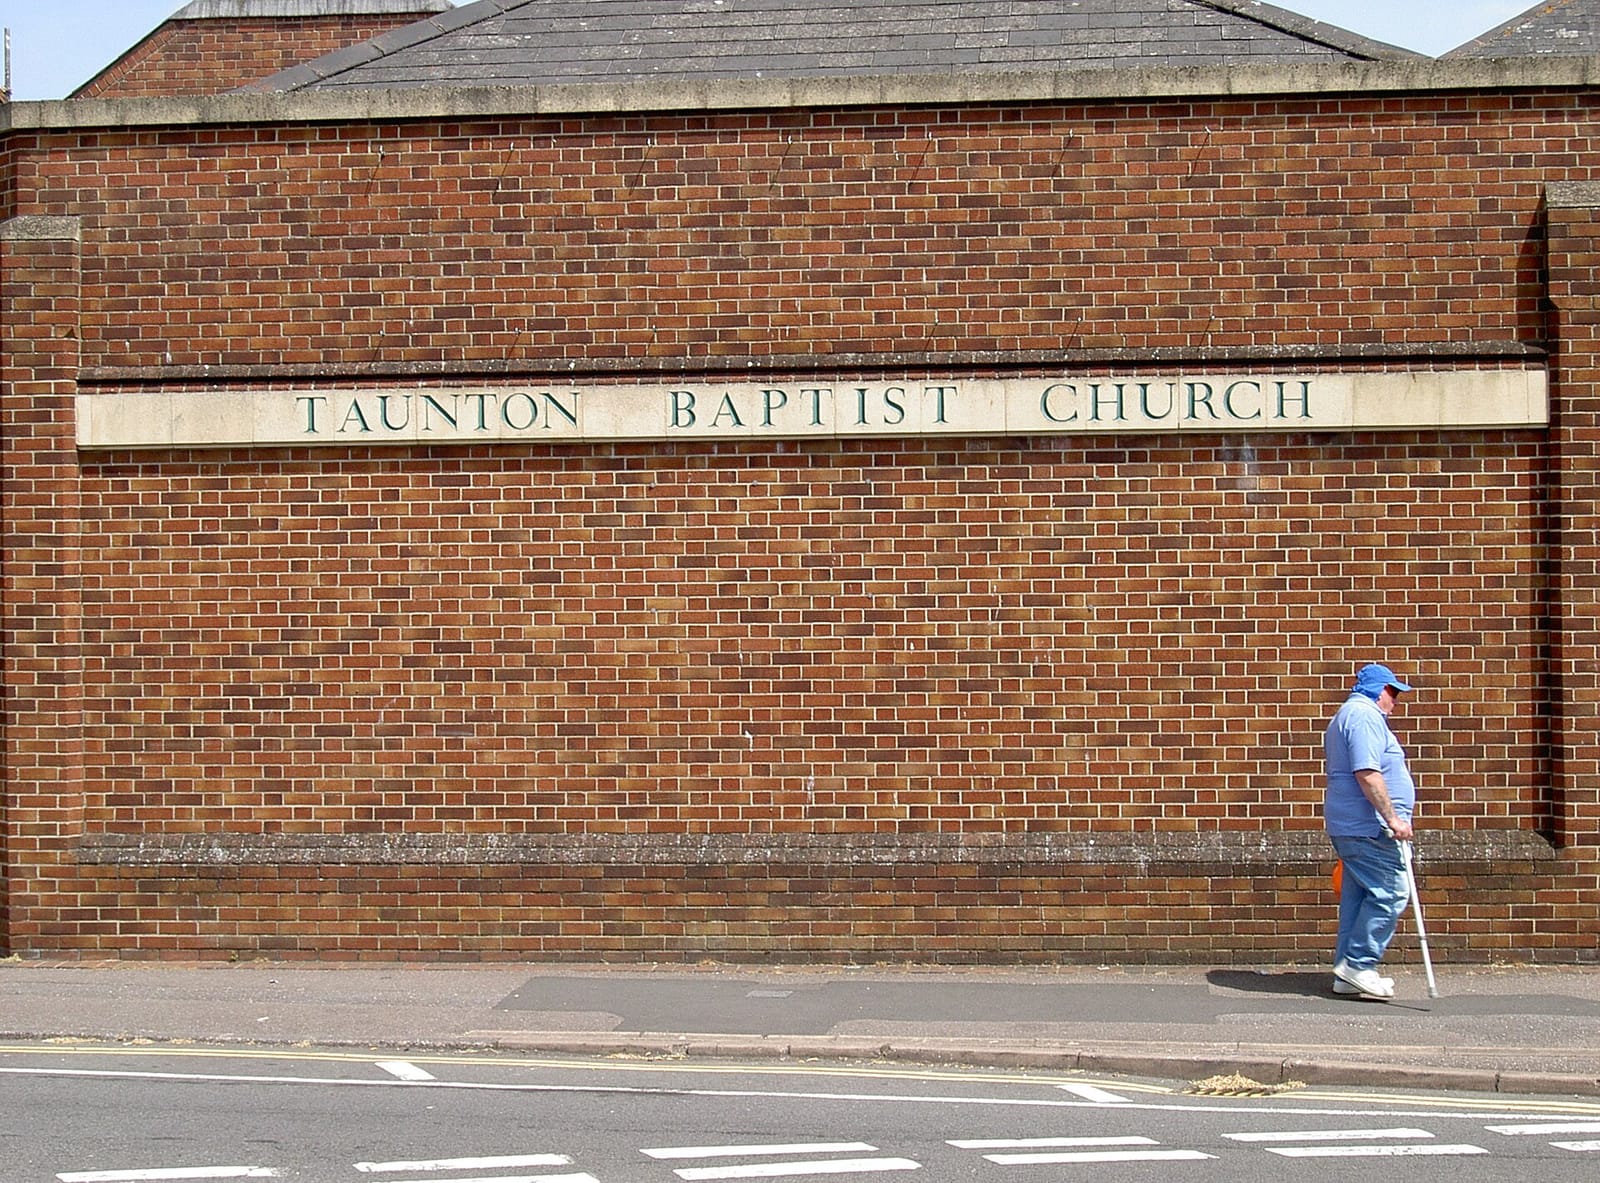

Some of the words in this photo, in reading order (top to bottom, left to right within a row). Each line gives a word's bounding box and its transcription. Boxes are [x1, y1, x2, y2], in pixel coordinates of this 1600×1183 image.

[295, 392, 580, 434] TAUNTON
[669, 387, 957, 428] BAPTIST
[1041, 379, 1314, 423] CHURCH
